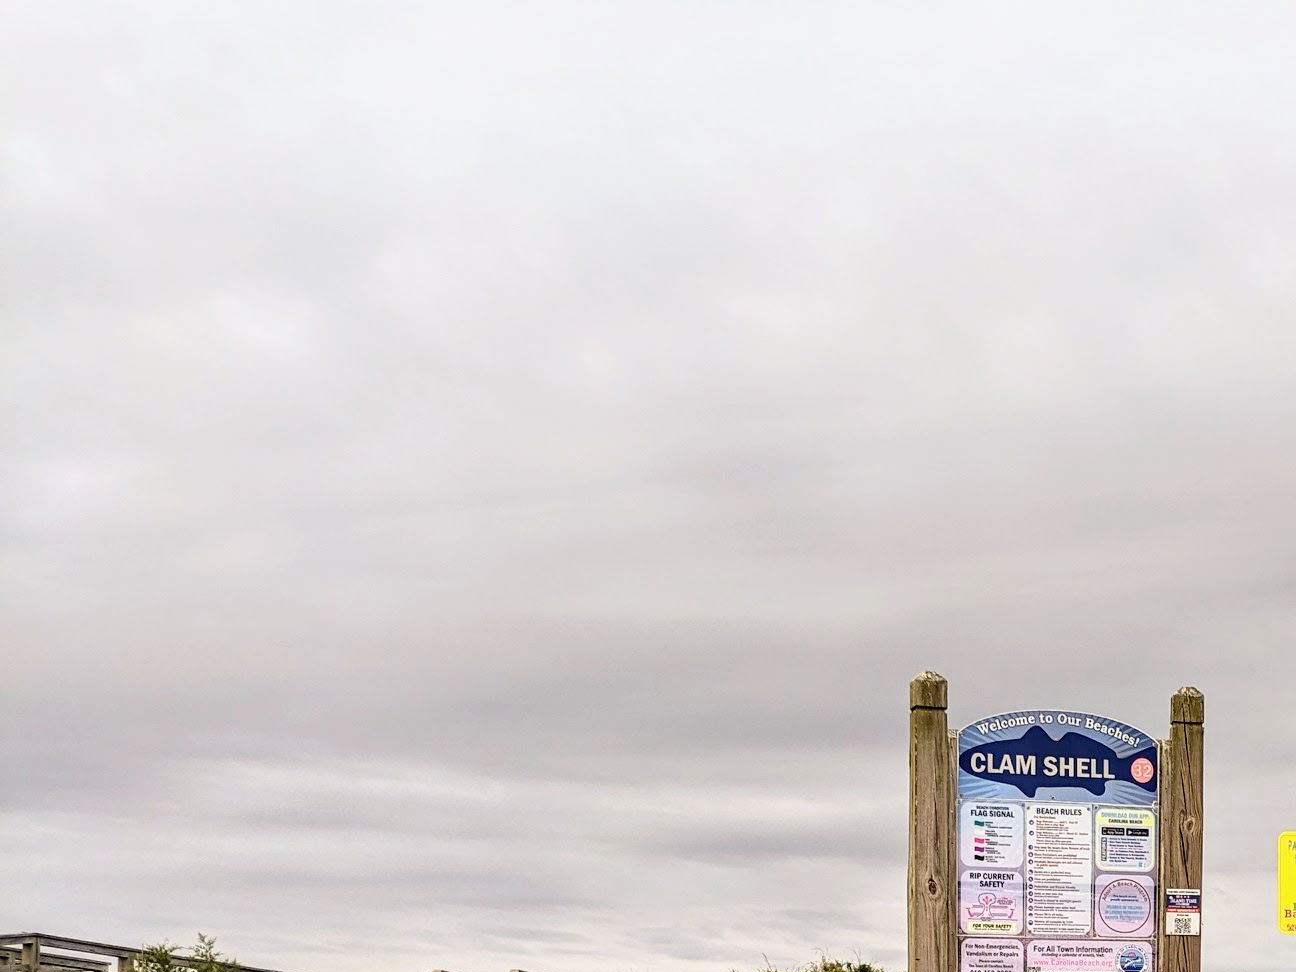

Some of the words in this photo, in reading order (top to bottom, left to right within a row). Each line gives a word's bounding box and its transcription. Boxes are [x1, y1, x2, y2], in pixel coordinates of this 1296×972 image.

[976, 714, 1036, 736] Welcome
[1040, 713, 1053, 724] to
[1057, 713, 1082, 727] Our
[1084, 717, 1141, 748] Beaches!
[970, 752, 1037, 776] CLAM
[1042, 756, 1116, 780] SHELL
[1133, 765, 1152, 778] 32
[1076, 945, 1113, 954] Information
